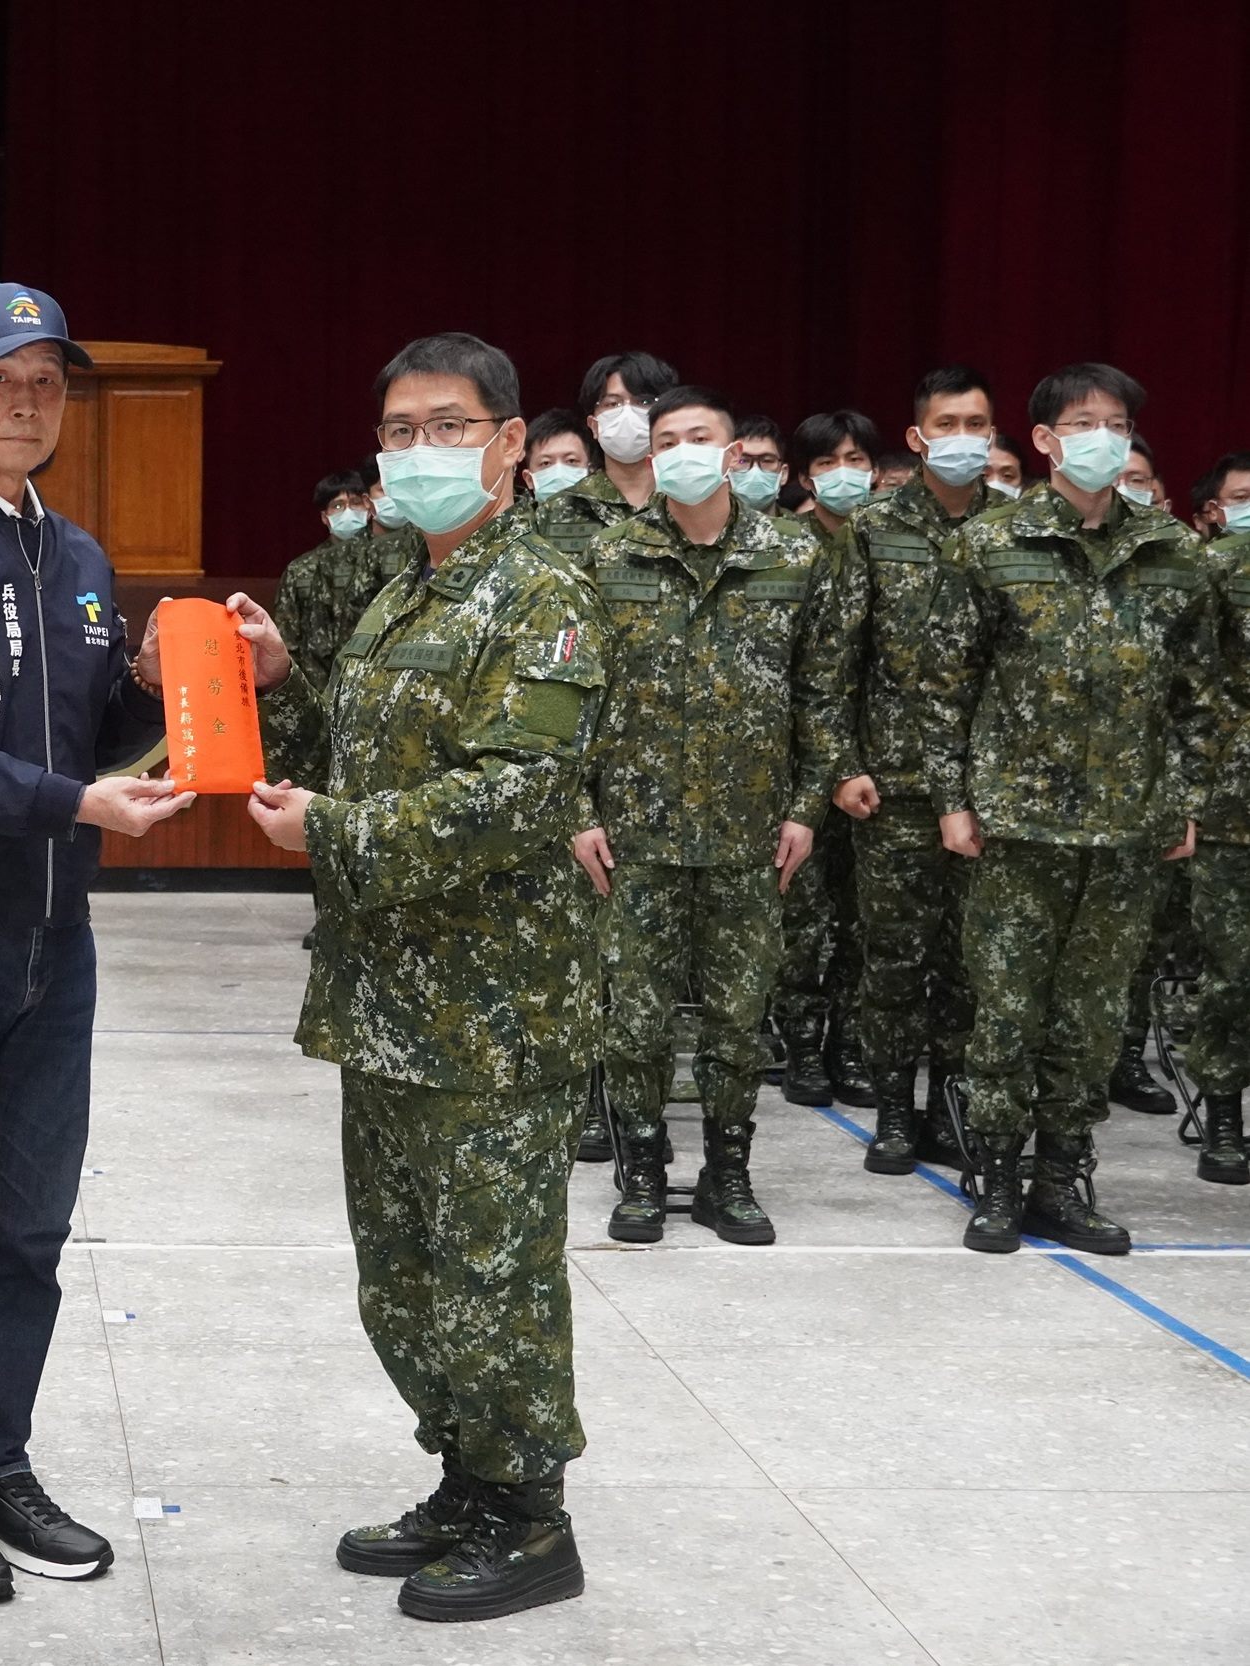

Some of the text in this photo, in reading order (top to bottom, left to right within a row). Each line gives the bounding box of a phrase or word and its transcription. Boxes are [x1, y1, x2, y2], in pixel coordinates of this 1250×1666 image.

[10, 316, 42, 326] TAIPEI
[2, 583, 22, 677] 兵役局局長
[83, 624, 109, 637] TAIPEI
[204, 639, 226, 734] 慰勞金
